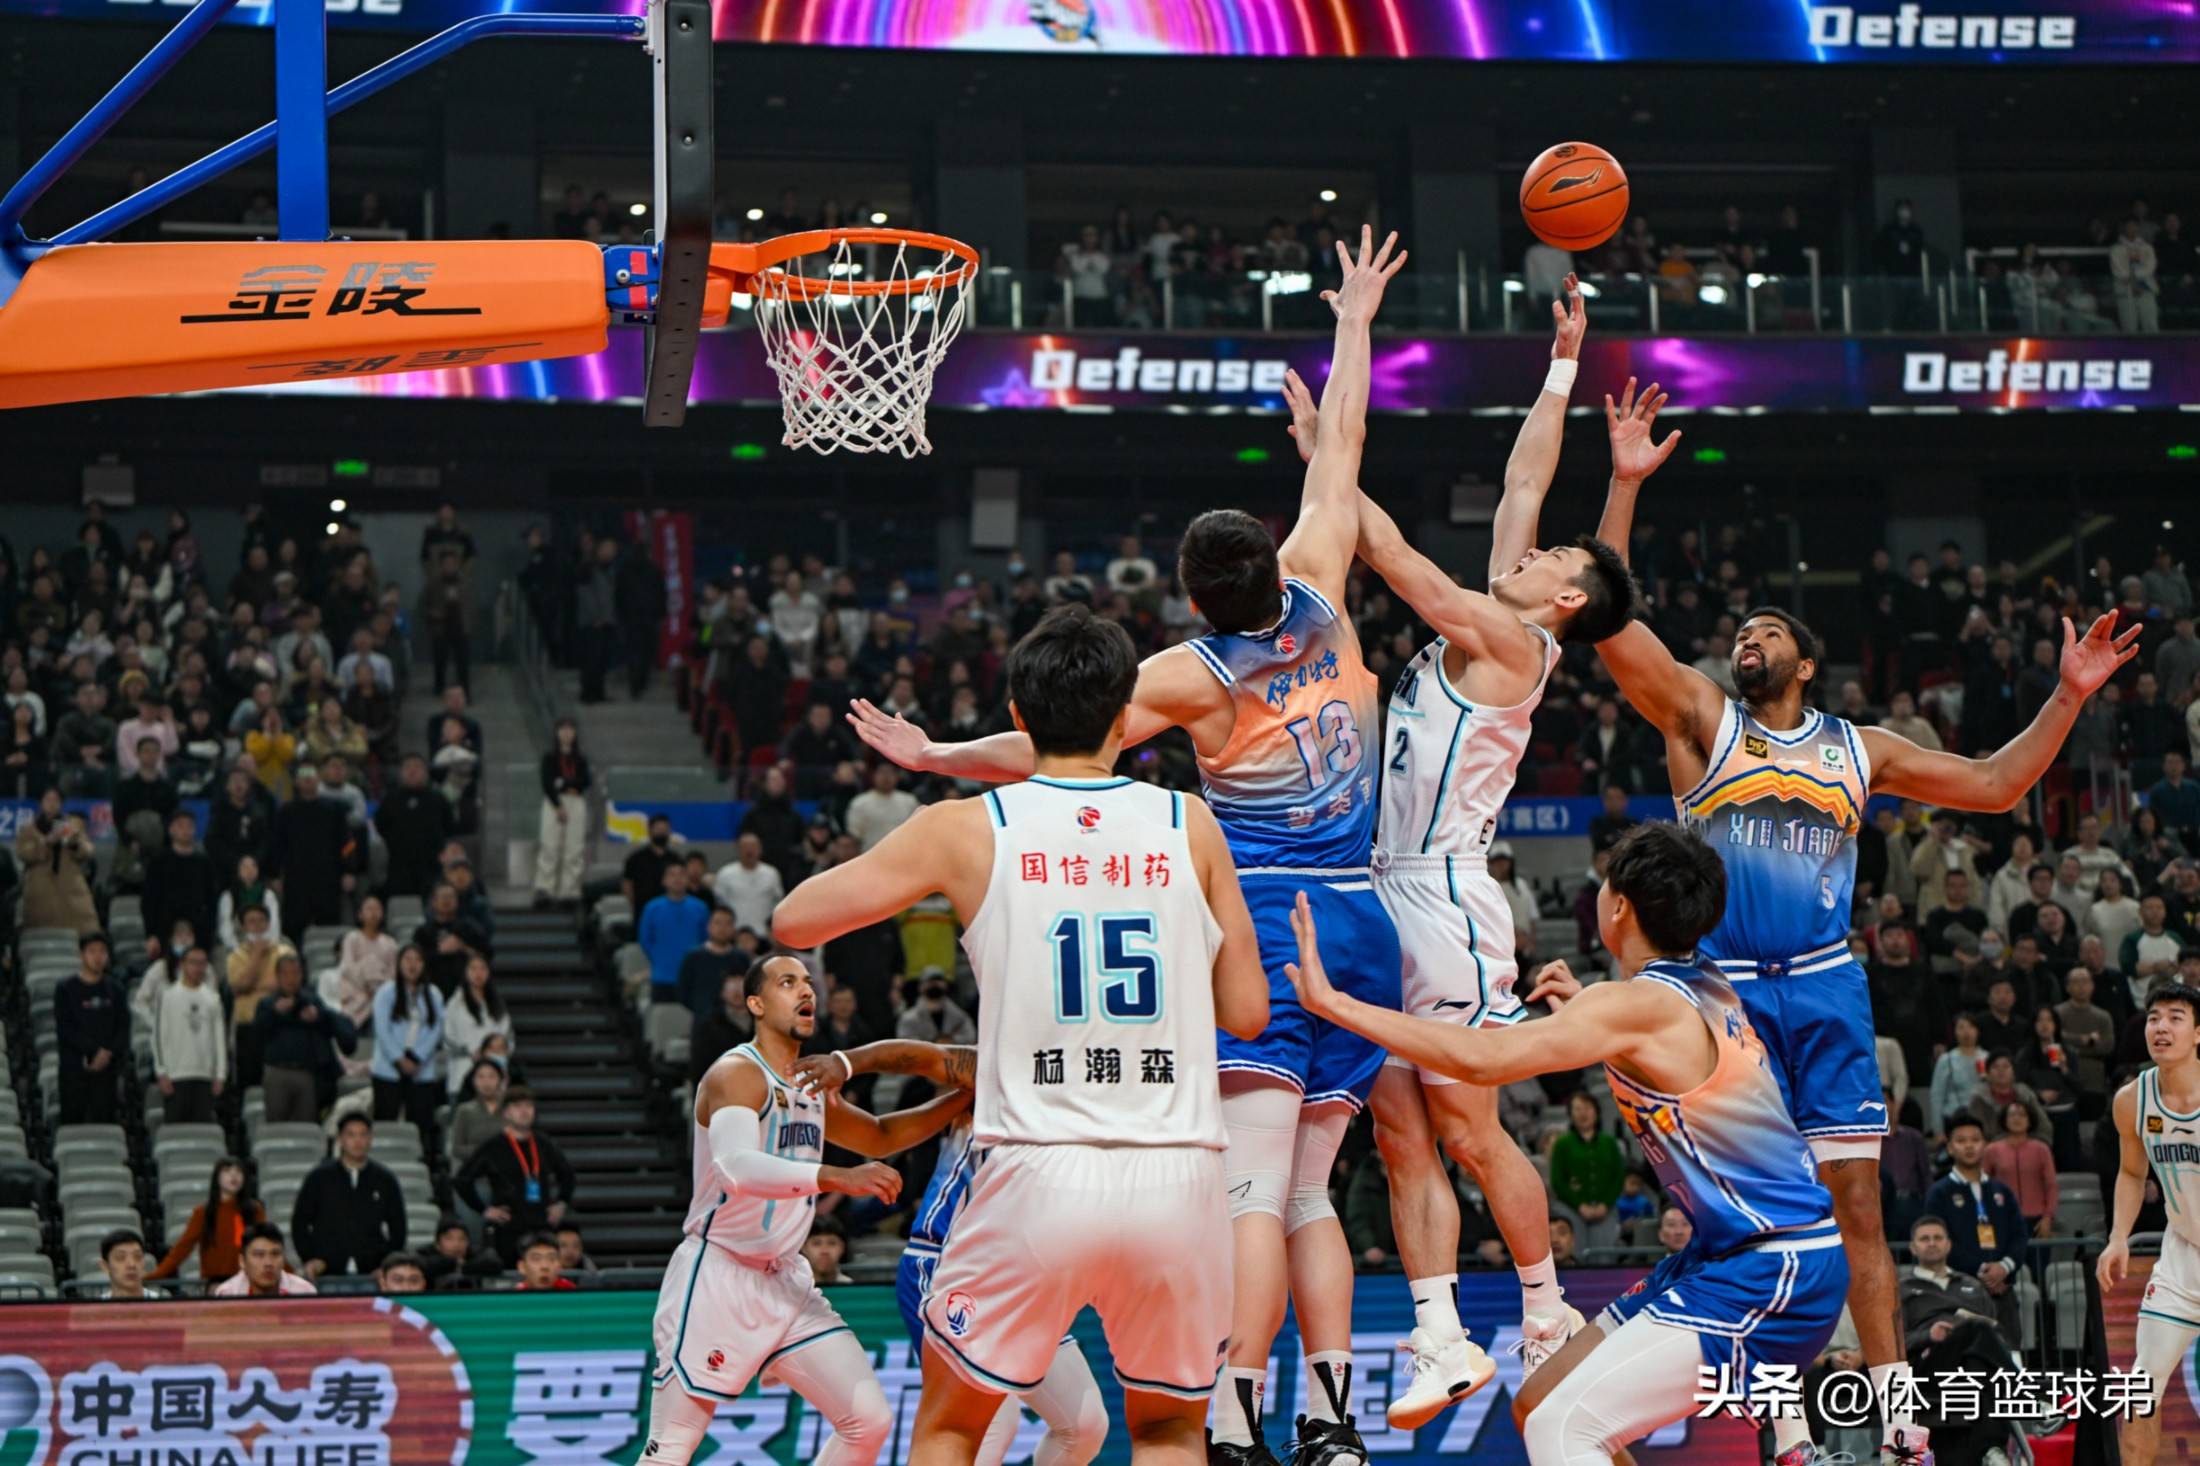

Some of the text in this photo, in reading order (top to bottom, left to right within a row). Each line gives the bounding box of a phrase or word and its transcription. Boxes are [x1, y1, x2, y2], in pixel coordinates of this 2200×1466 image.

[1808, 3, 2075, 48] Defense
[181, 262, 482, 323] 金陵
[1030, 348, 1286, 392] Defense
[1904, 352, 2152, 391] Defense
[1285, 700, 1363, 790] 13
[1728, 812, 1774, 849] XIN
[1020, 852, 1170, 888] 国信制药
[1819, 874, 1837, 910] 5
[1044, 910, 1164, 1025] 15
[1033, 1047, 1175, 1085] 杨瀚森
[71, 1371, 385, 1437] 中国人寿
